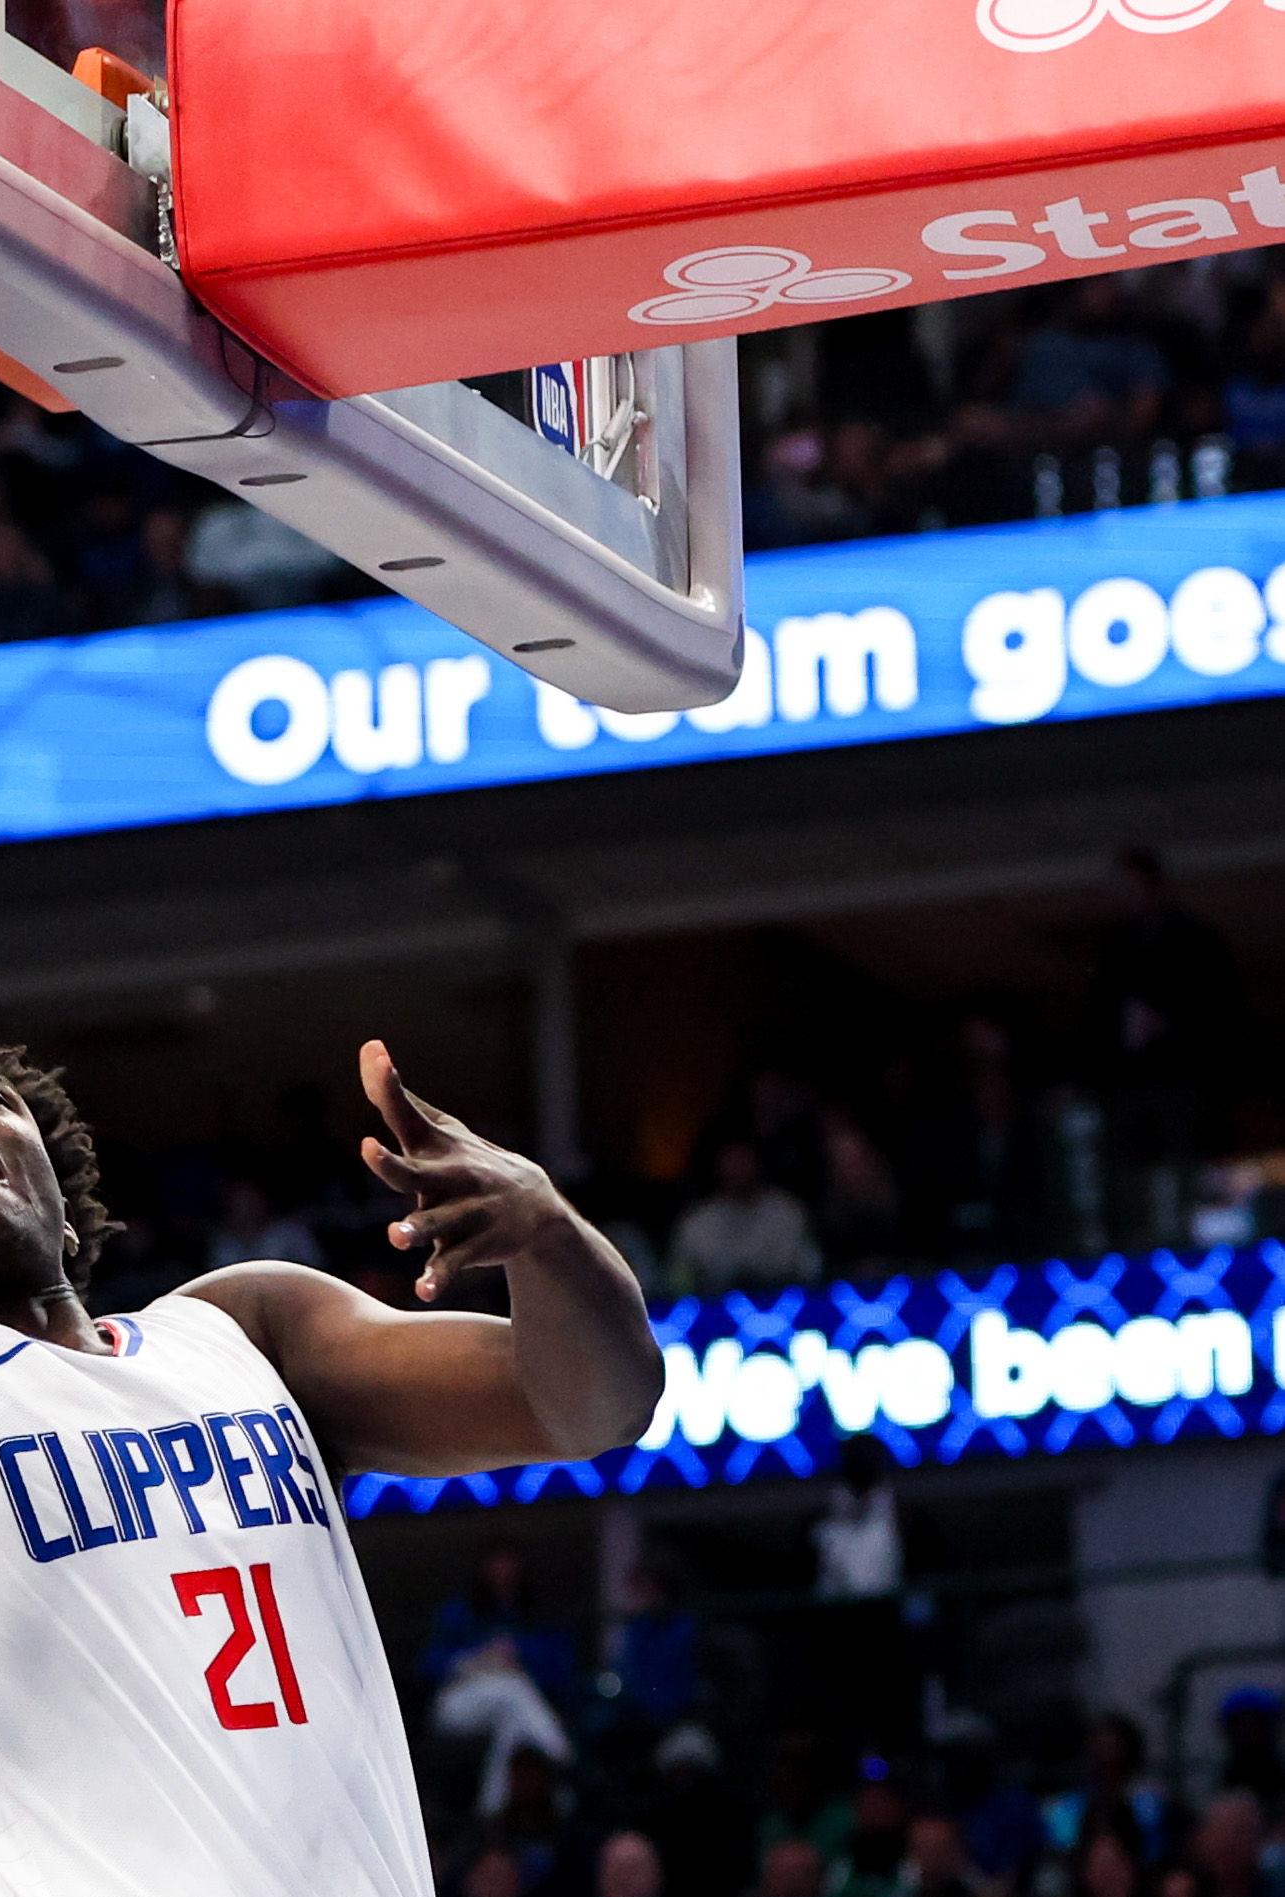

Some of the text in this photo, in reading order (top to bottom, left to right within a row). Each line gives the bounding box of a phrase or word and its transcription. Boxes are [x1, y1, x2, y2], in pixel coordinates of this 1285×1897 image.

[540, 371, 569, 438] NBA
[207, 654, 490, 785] Our
[536, 604, 918, 750] tam
[635, 1329, 954, 1450] We've
[970, 1307, 1253, 1420] been
[170, 1563, 309, 1731] 21
